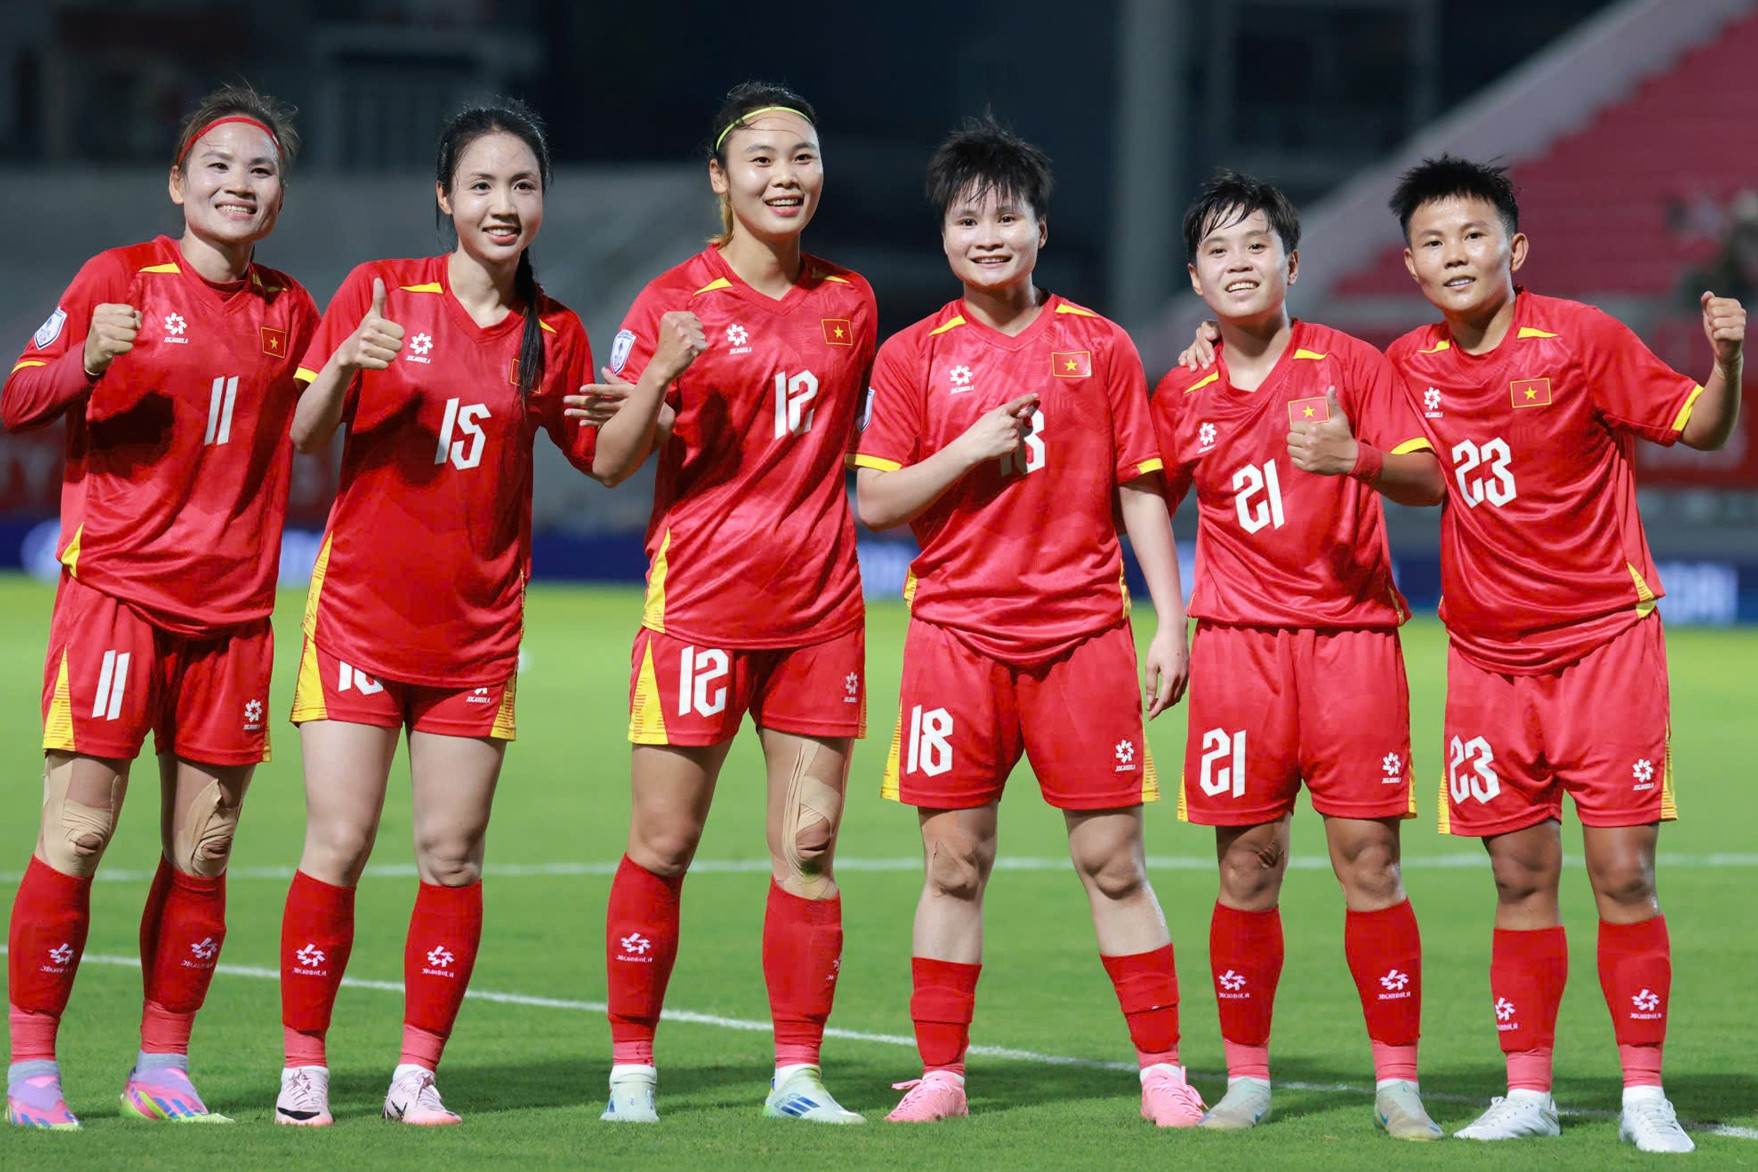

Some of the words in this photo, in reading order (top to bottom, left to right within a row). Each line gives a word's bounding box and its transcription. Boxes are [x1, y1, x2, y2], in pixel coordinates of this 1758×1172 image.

[204, 376, 239, 446] 11
[434, 397, 492, 470] 15
[775, 369, 818, 440] 12
[1001, 409, 1045, 477] 8
[1452, 436, 1517, 508] 23
[1232, 458, 1285, 534] 21
[92, 650, 130, 721] 11
[679, 646, 729, 718] 12
[907, 705, 954, 777] 18
[1200, 727, 1246, 799] 21
[1450, 735, 1501, 804] 23
